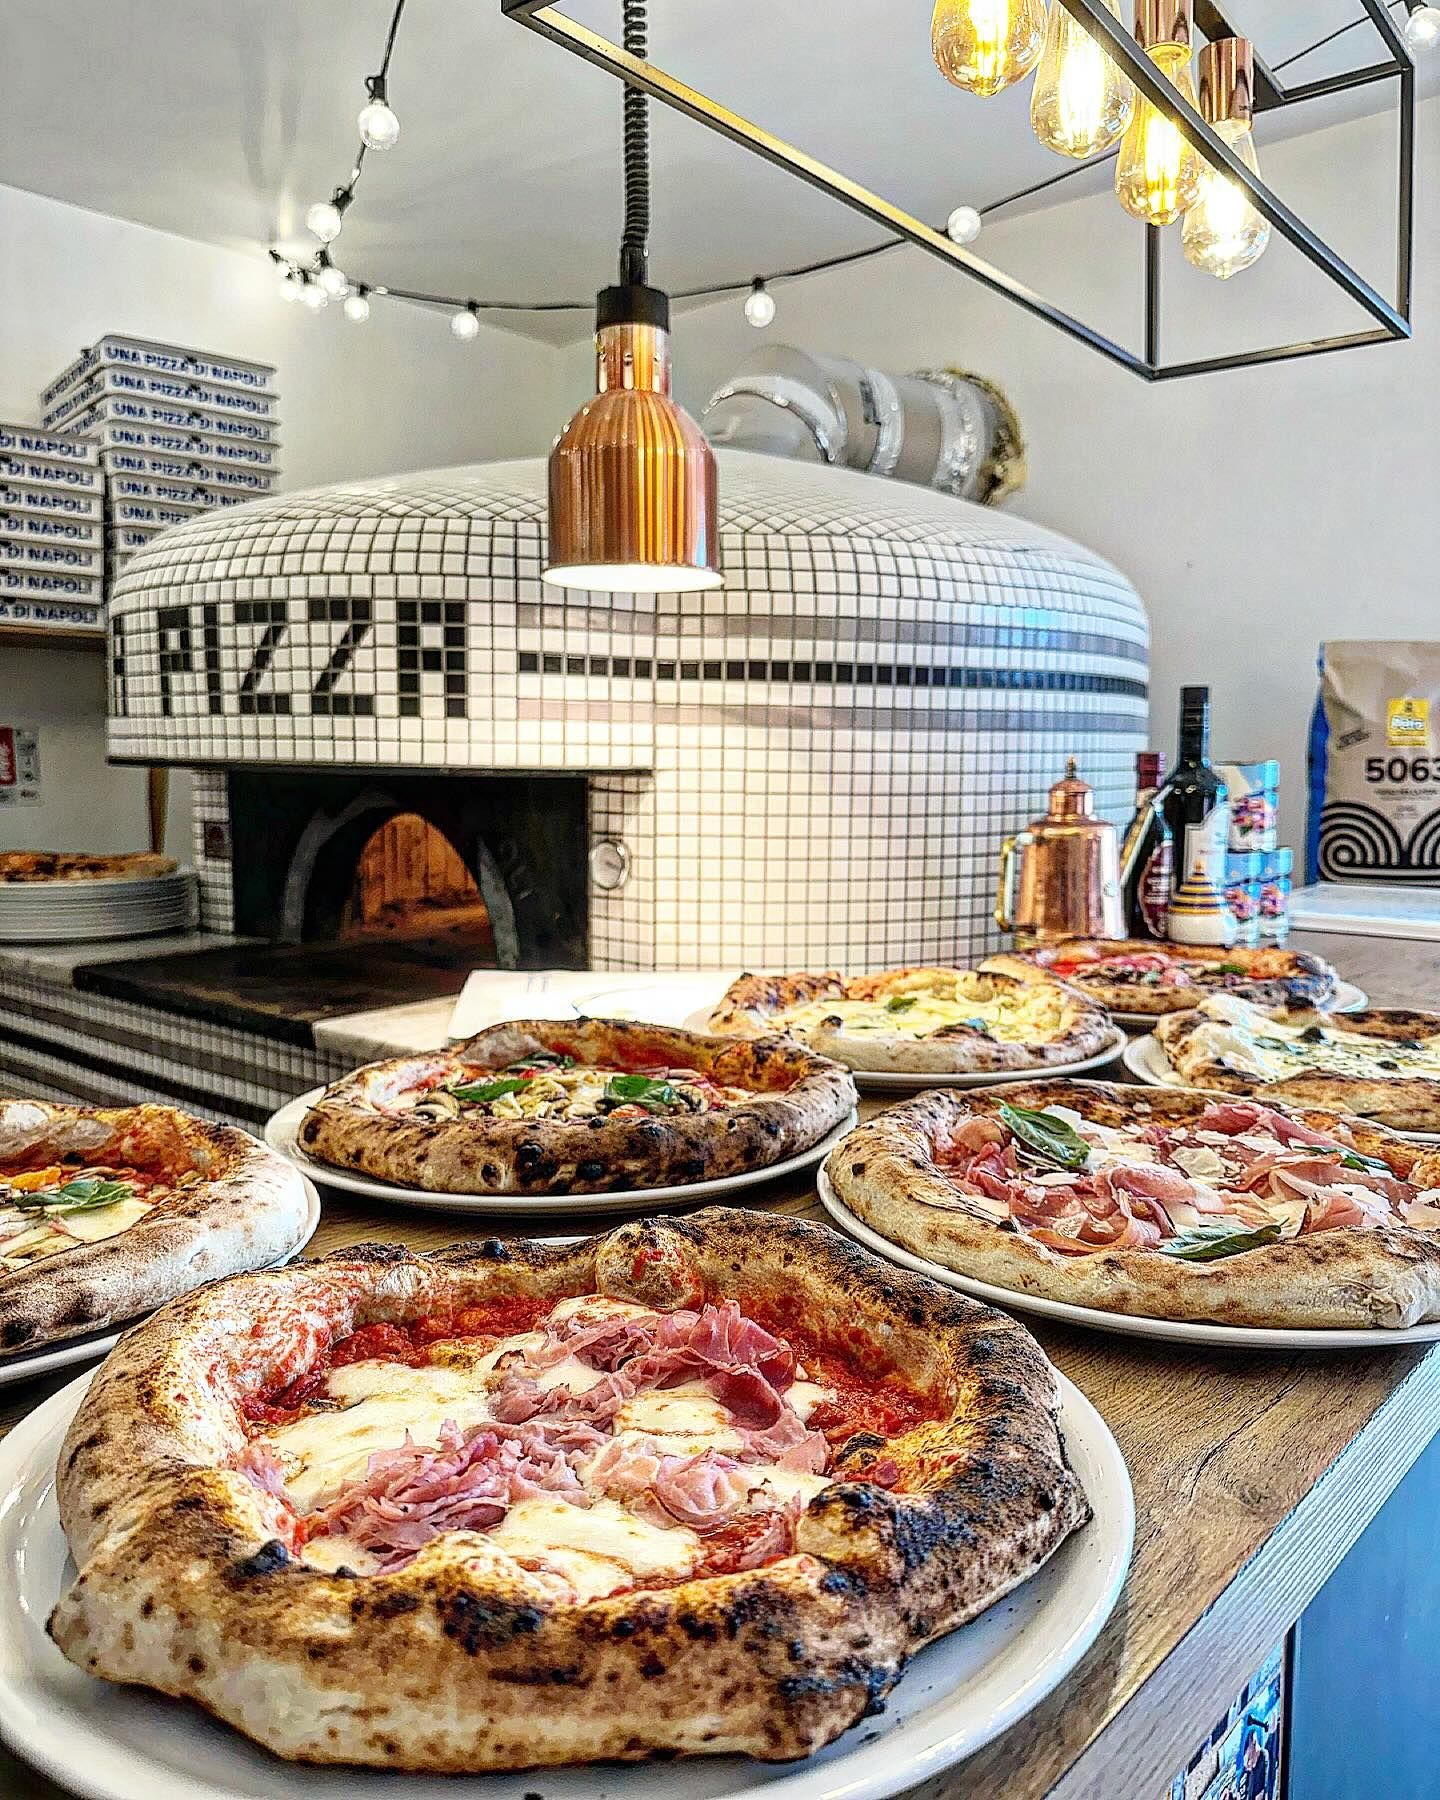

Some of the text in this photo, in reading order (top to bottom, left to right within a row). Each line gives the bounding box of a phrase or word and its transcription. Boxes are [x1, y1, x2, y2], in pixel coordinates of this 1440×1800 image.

[105, 346, 267, 387] UNA PIZZA DI NAPOLI
[111, 374, 269, 414] UNA PIZZA DI NAPOLI
[113, 402, 270, 440] UNA PIZZA DI NAPOLI
[20, 437, 87, 457] NAPOLI
[111, 429, 271, 464] UNA PIZZA DI NAPOLI
[31, 466, 94, 487] NAPOLI
[112, 455, 270, 490] UNA PIZZA DI NAPOLI
[26, 494, 92, 513] NAPOLI
[28, 520, 92, 539] NAPOLI
[28, 548, 92, 566] NAPOLI
[28, 575, 92, 594] NAPOLI
[35, 607, 97, 623] NAPOLI
[158, 600, 466, 717] PIZZA
